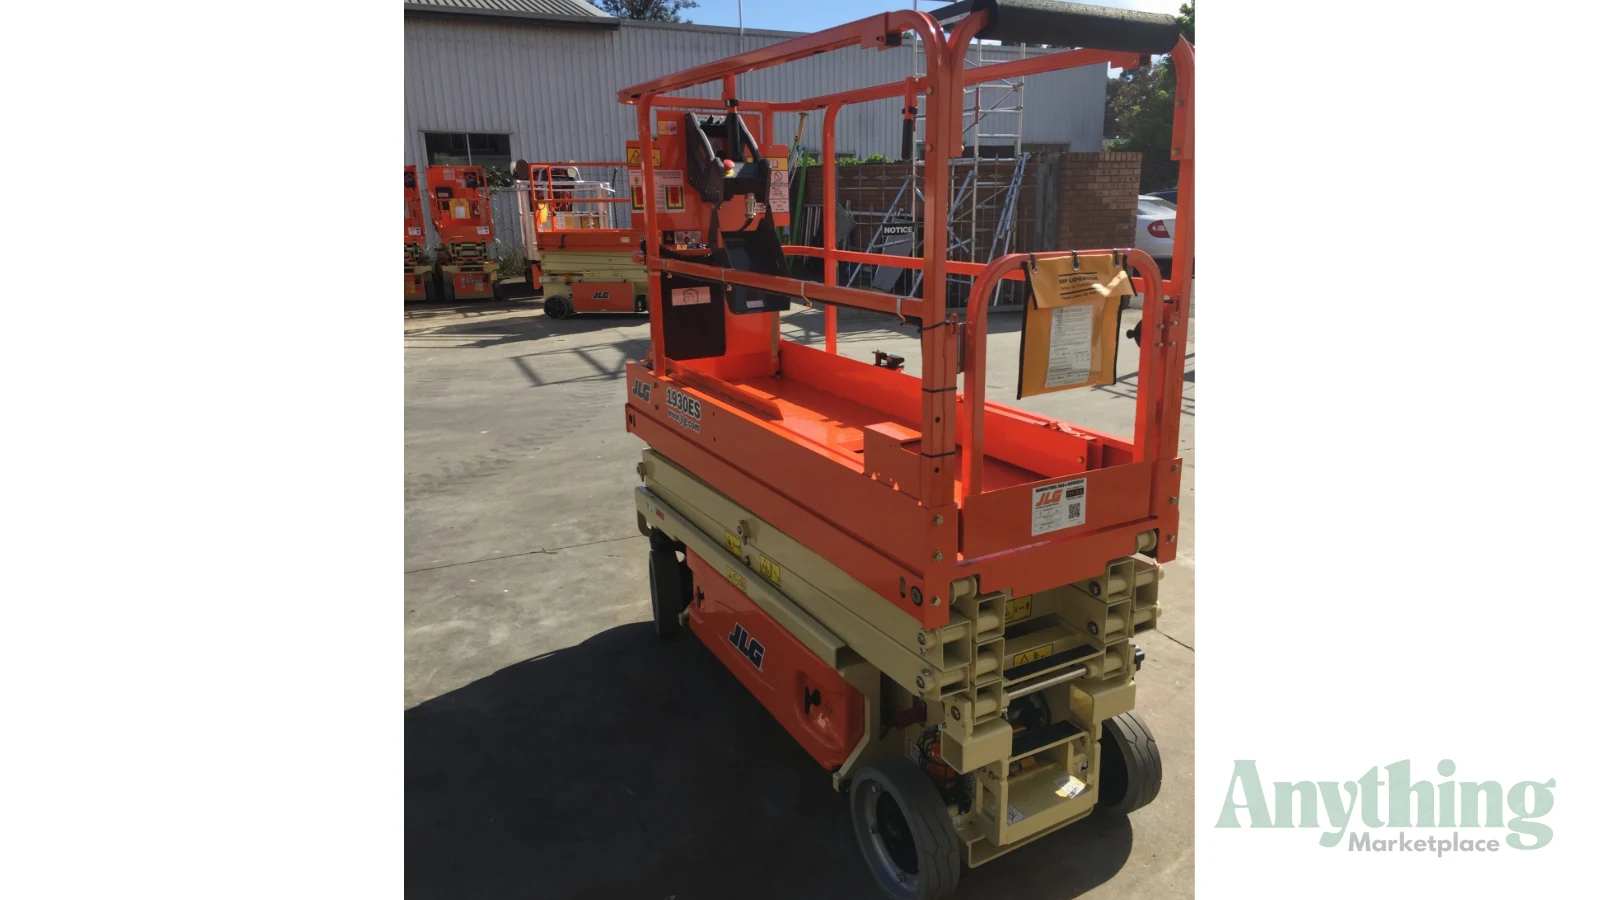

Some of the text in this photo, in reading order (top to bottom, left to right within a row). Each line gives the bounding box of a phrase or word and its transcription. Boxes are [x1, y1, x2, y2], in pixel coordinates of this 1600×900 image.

[884, 226, 914, 234] NOTICE
[592, 291, 610, 299] JLG
[632, 378, 651, 403] JLG
[666, 387, 701, 420] 1930ES
[667, 409, 700, 433] www.jlg.com
[1036, 489, 1063, 507] JLG
[728, 622, 765, 671] JLG
